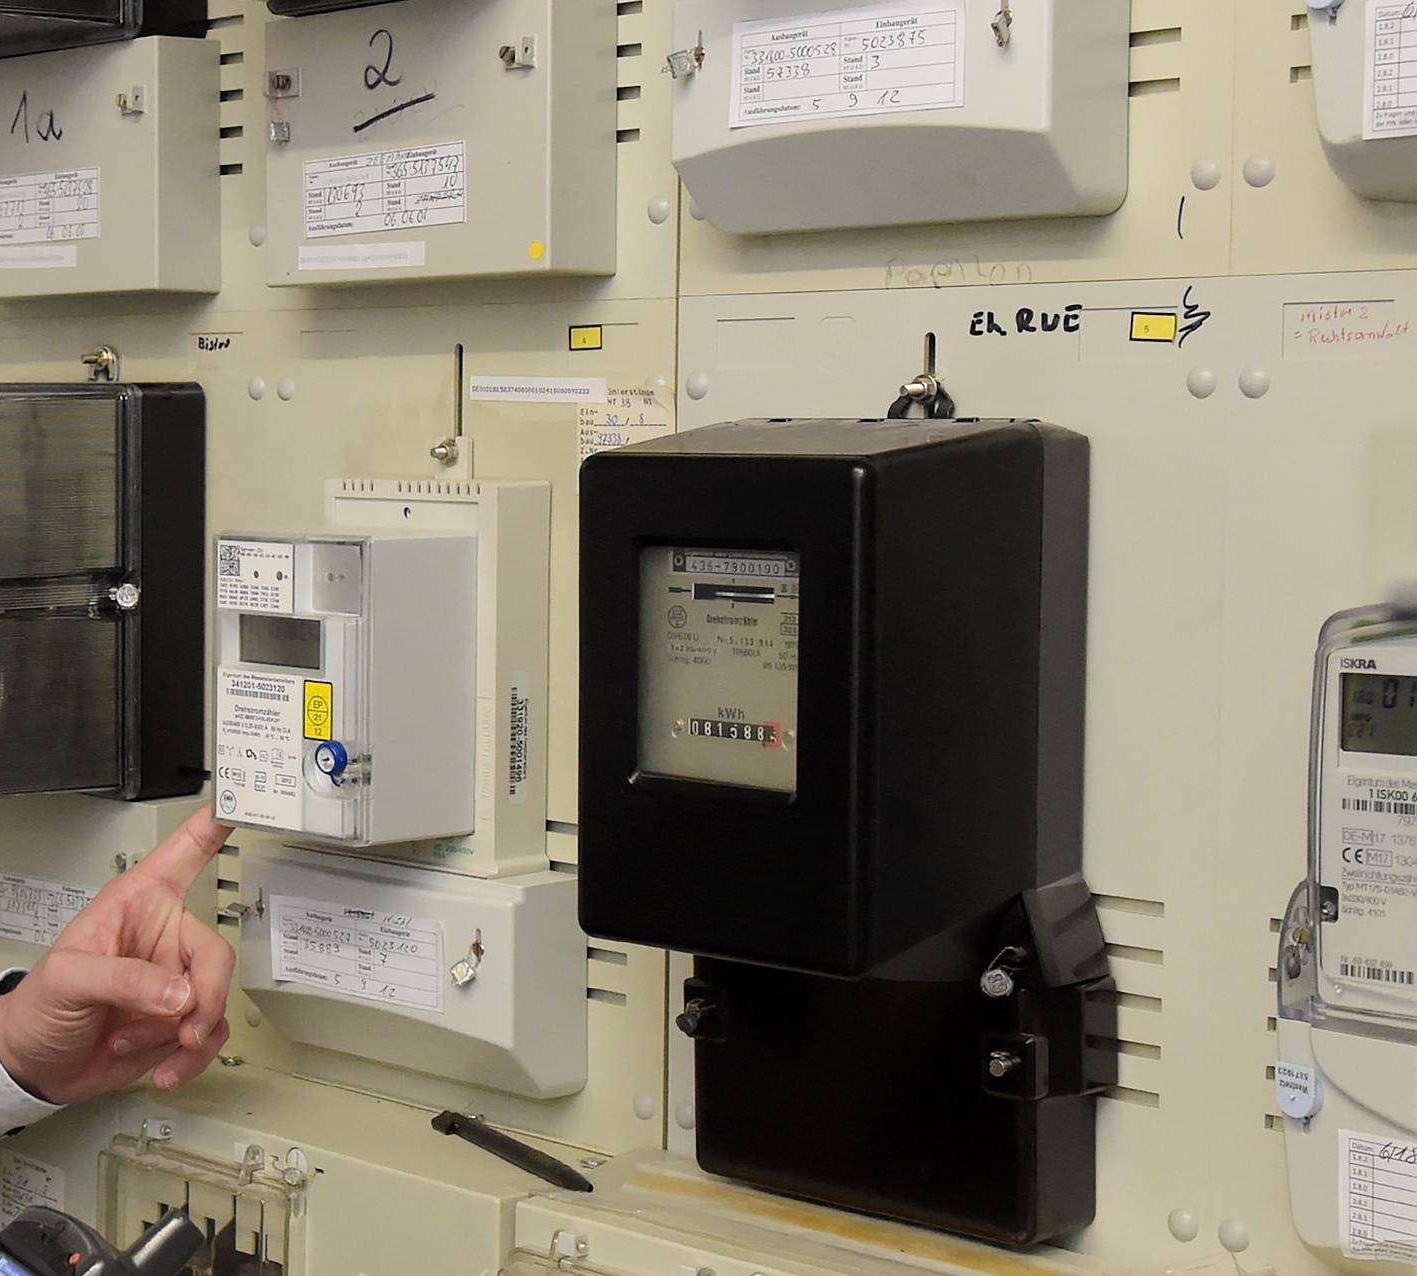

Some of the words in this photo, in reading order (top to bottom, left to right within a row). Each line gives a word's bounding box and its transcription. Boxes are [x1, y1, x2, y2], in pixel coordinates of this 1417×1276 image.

[364, 29, 402, 90] 2
[843, 55, 863, 64] Stand
[870, 55, 880, 70] 3
[843, 74, 863, 83] Stand
[812, 98, 823, 111] 5
[848, 93, 859, 108] 9
[1341, 658, 1377, 669] ISKRA
[313, 700, 323, 709] EP
[313, 713, 322, 722] 21
[717, 706, 745, 720] kWh
[314, 727, 322, 736] 12
